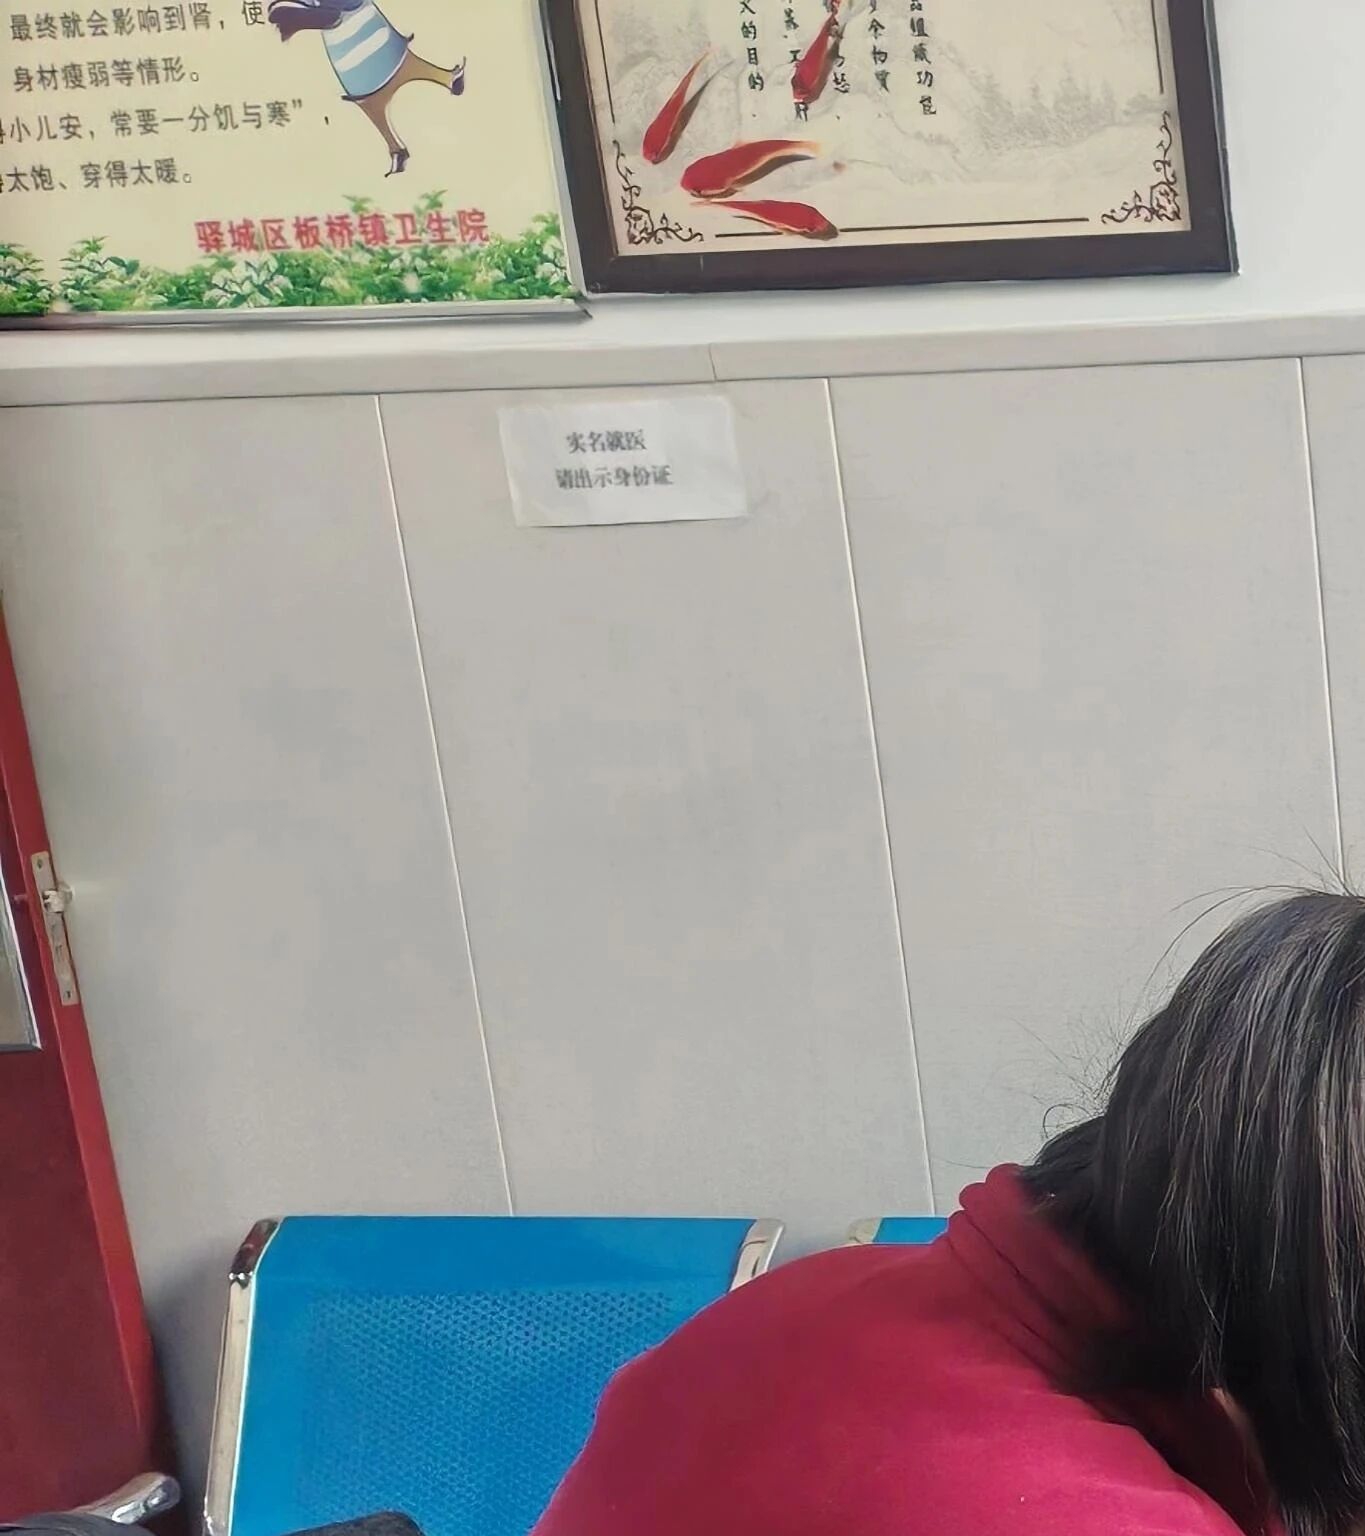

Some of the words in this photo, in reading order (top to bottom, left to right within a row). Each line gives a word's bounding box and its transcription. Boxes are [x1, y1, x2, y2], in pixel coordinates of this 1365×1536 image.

[13, 56, 200, 92] 身材瘦弱等情形。
[0, 98, 330, 144] 小儿安，常要一分饥与寒”，
[0, 157, 192, 194] 太饱、穿得太暖。
[194, 208, 490, 253] 驿城区板桥镇卫生院
[566, 429, 647, 454] 实名就医
[554, 465, 673, 490] 请出示身份证
